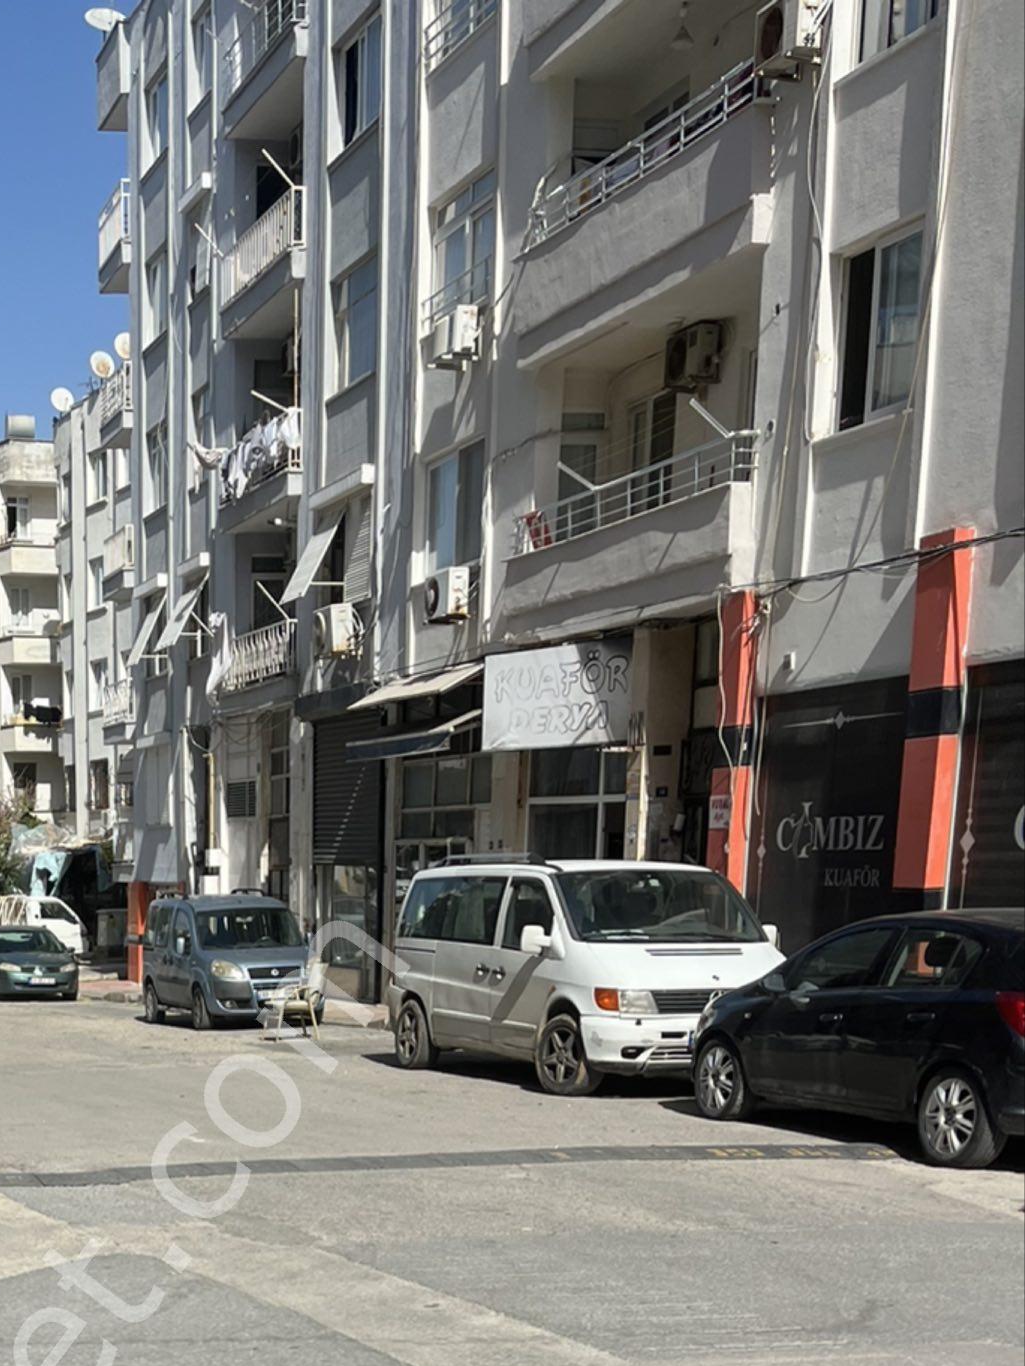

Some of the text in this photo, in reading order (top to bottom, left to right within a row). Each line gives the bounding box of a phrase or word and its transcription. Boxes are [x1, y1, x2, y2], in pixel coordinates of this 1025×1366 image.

[495, 649, 630, 703] KUAFÖR
[509, 701, 609, 736] DERYA
[823, 865, 880, 888] KUAFÖR
